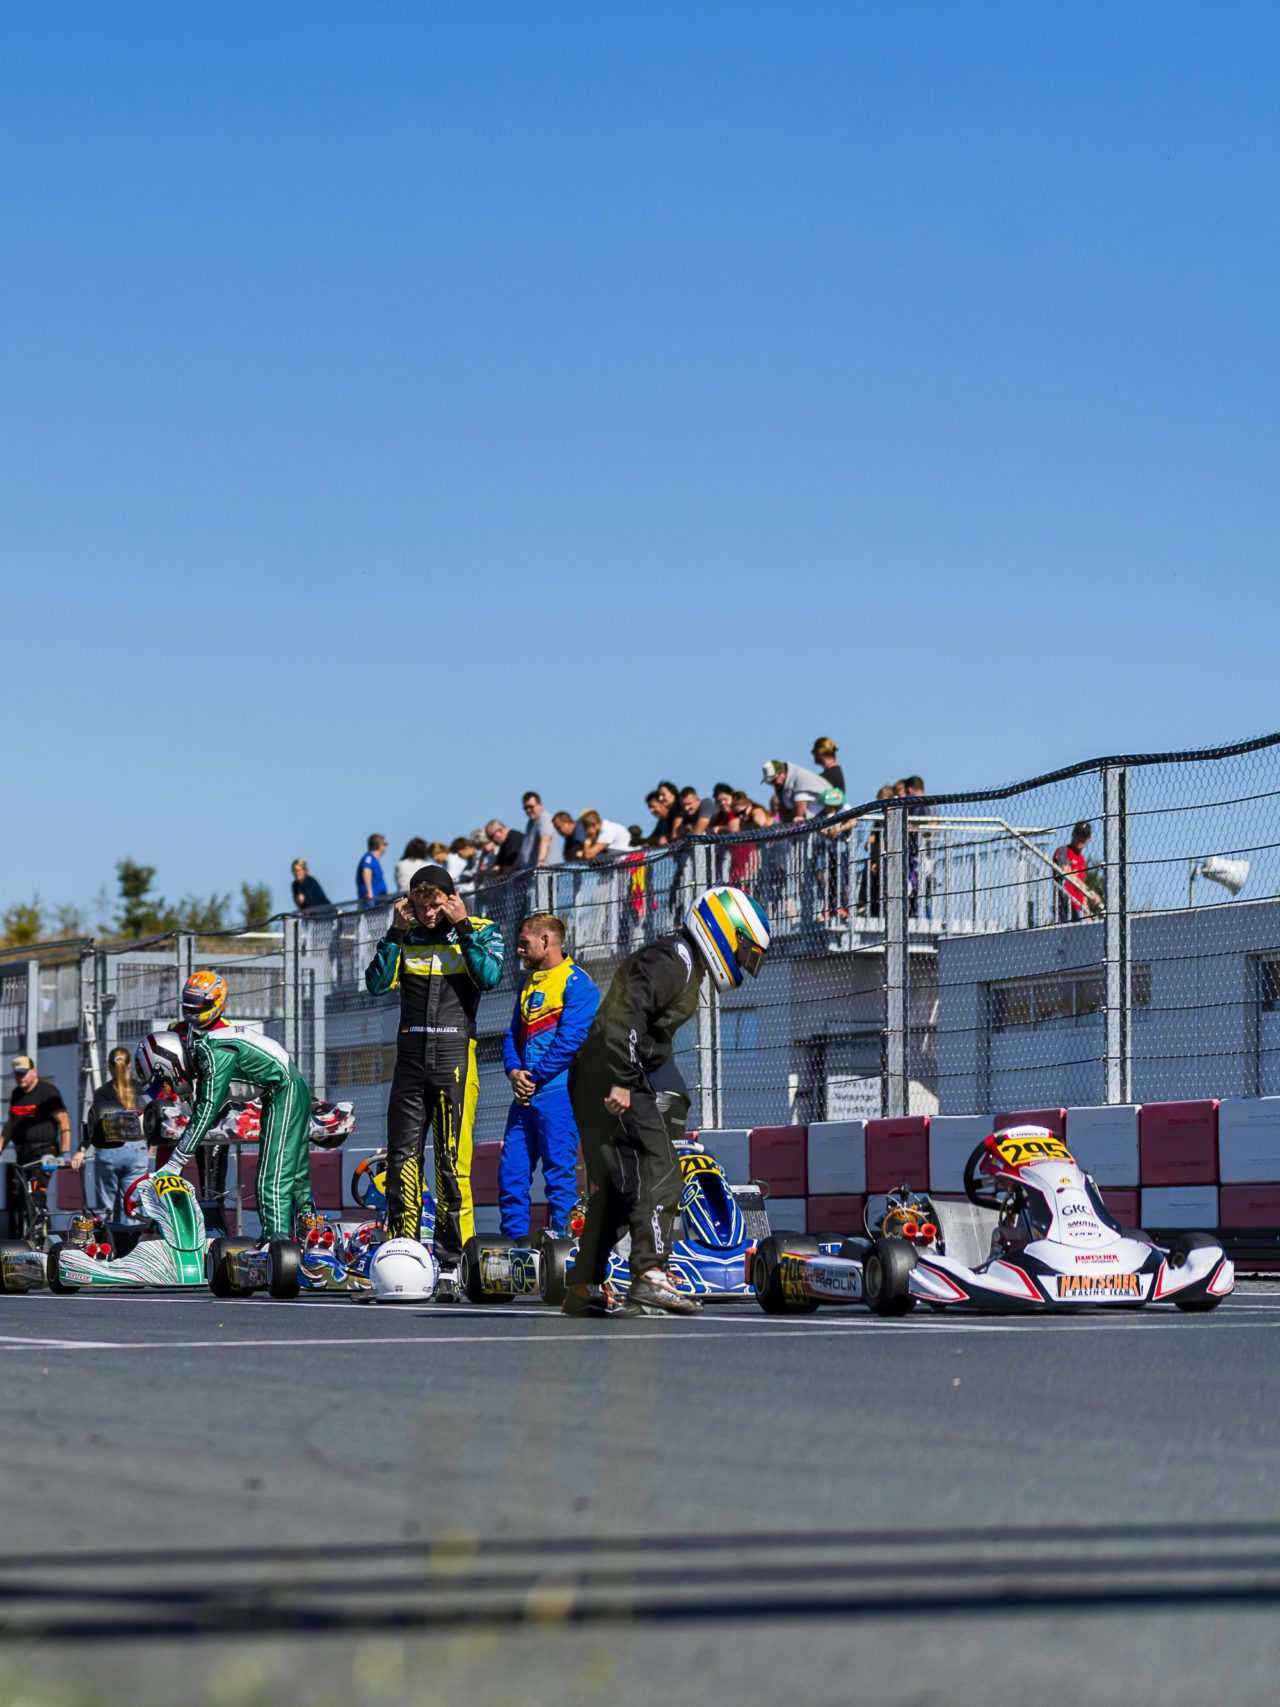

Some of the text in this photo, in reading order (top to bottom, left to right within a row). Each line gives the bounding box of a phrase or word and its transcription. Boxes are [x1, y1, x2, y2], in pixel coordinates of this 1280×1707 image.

[1001, 1142, 1071, 1163] 295
[1075, 1254, 1119, 1264] HANTSCHER
[815, 1276, 857, 1291] PAROLIN
[1061, 1274, 1139, 1297] HANTSCHER
[1072, 1288, 1130, 1296] RACING TEAM
